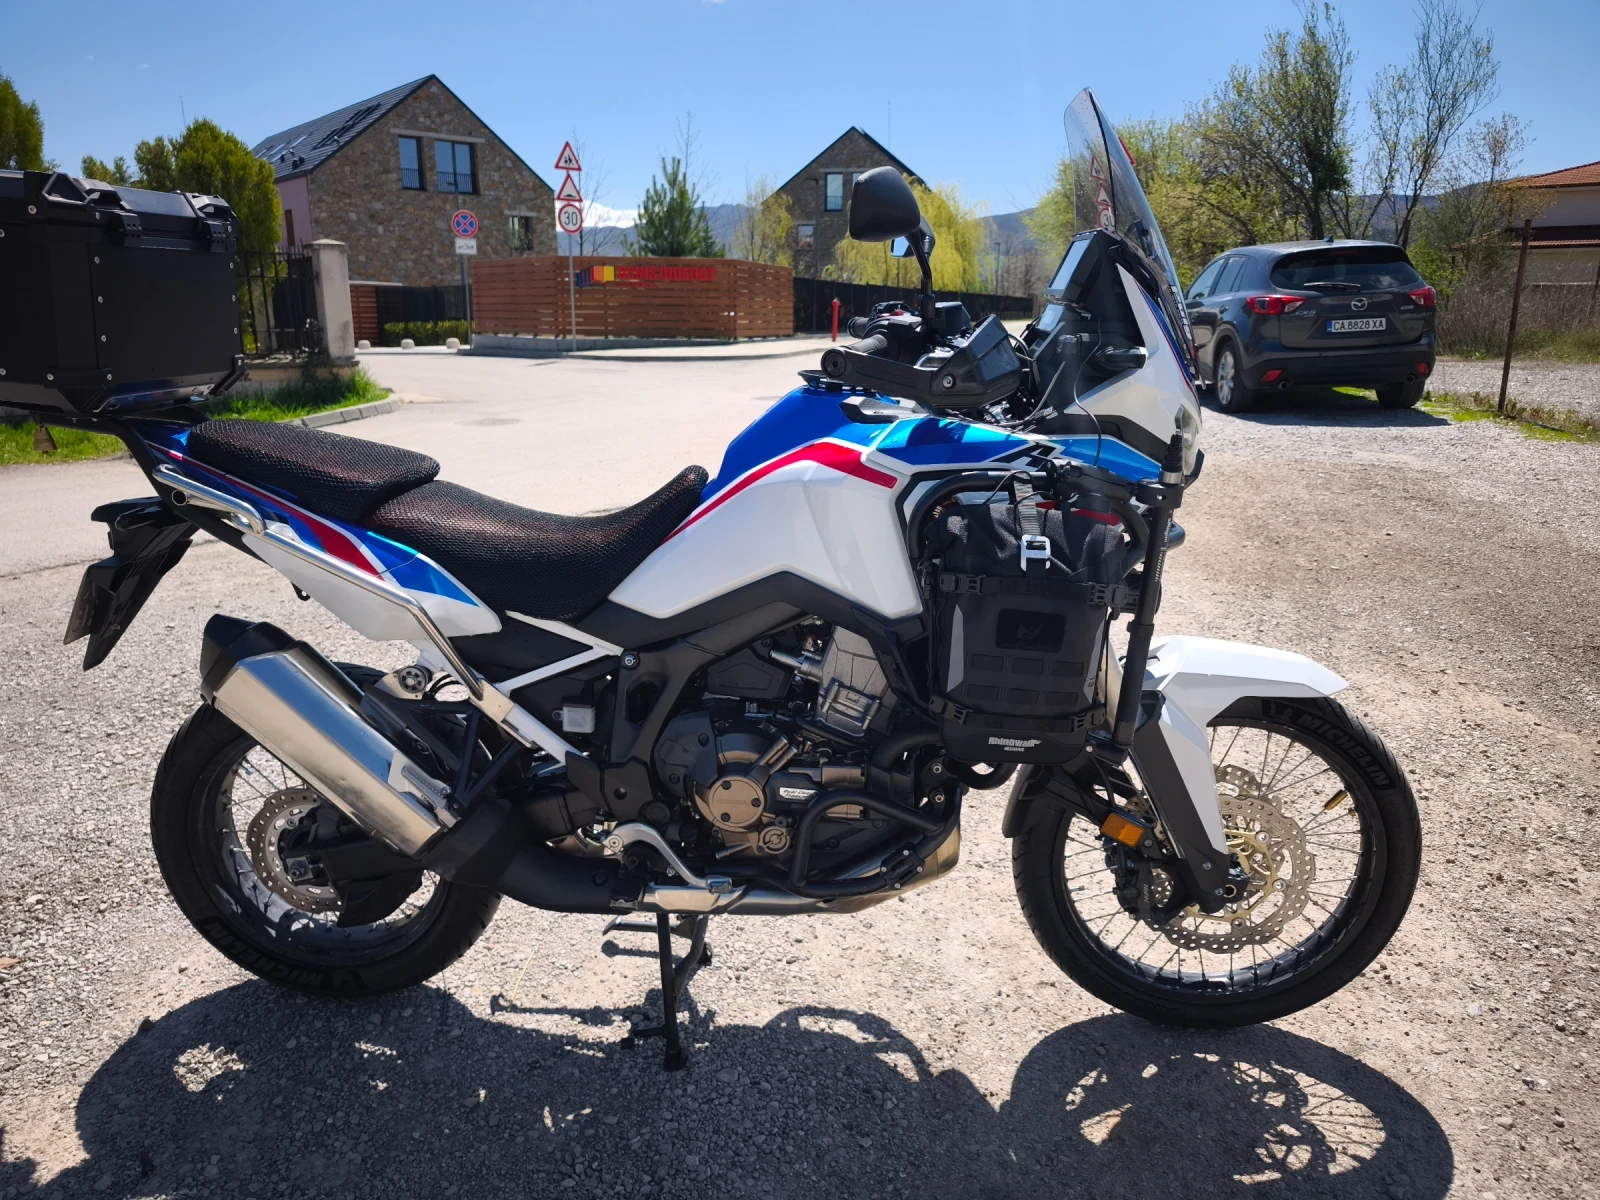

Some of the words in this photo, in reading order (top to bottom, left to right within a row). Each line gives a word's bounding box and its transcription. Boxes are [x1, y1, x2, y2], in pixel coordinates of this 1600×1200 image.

[563, 210, 578, 226] 30
[1298, 713, 1391, 790] MICHELIN
[203, 921, 324, 988] MICHELIN
